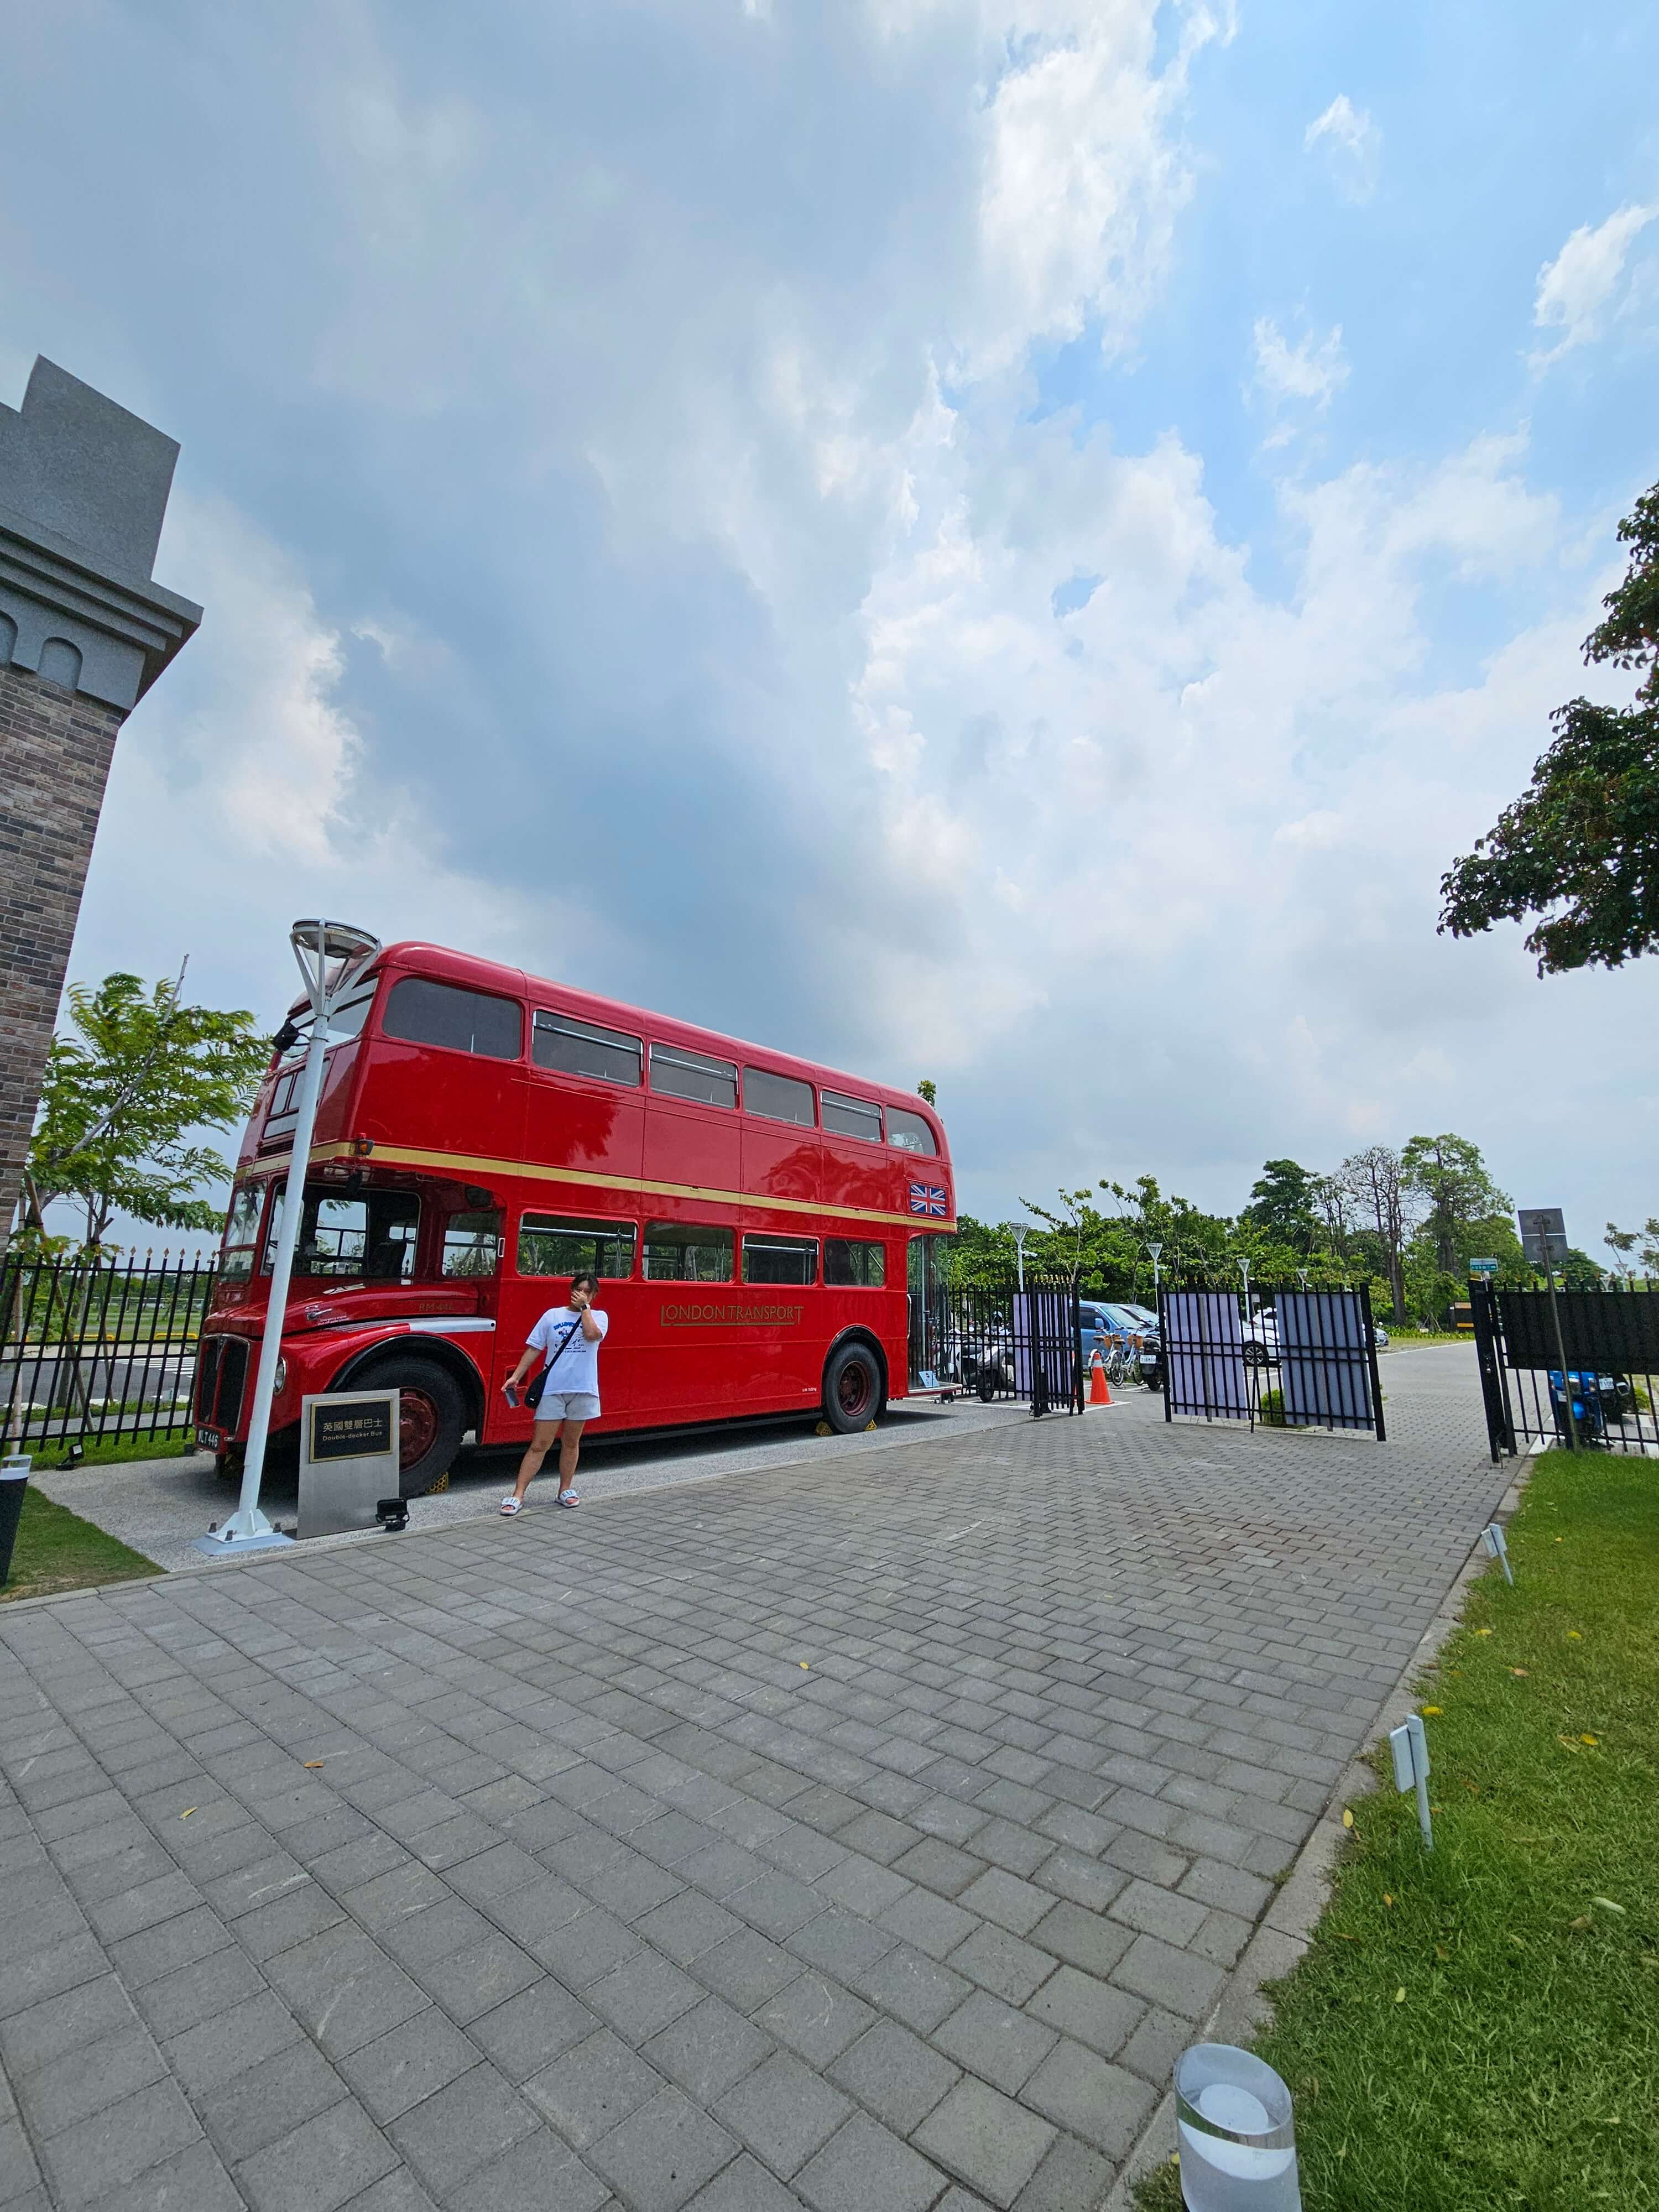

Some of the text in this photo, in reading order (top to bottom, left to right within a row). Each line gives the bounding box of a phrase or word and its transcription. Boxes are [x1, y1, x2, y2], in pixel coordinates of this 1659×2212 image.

[661, 1305, 804, 1327] LONDON TRANSPORT
[323, 1418, 383, 1433] 英國雙層巴士
[322, 1432, 369, 1441] Double-decker
